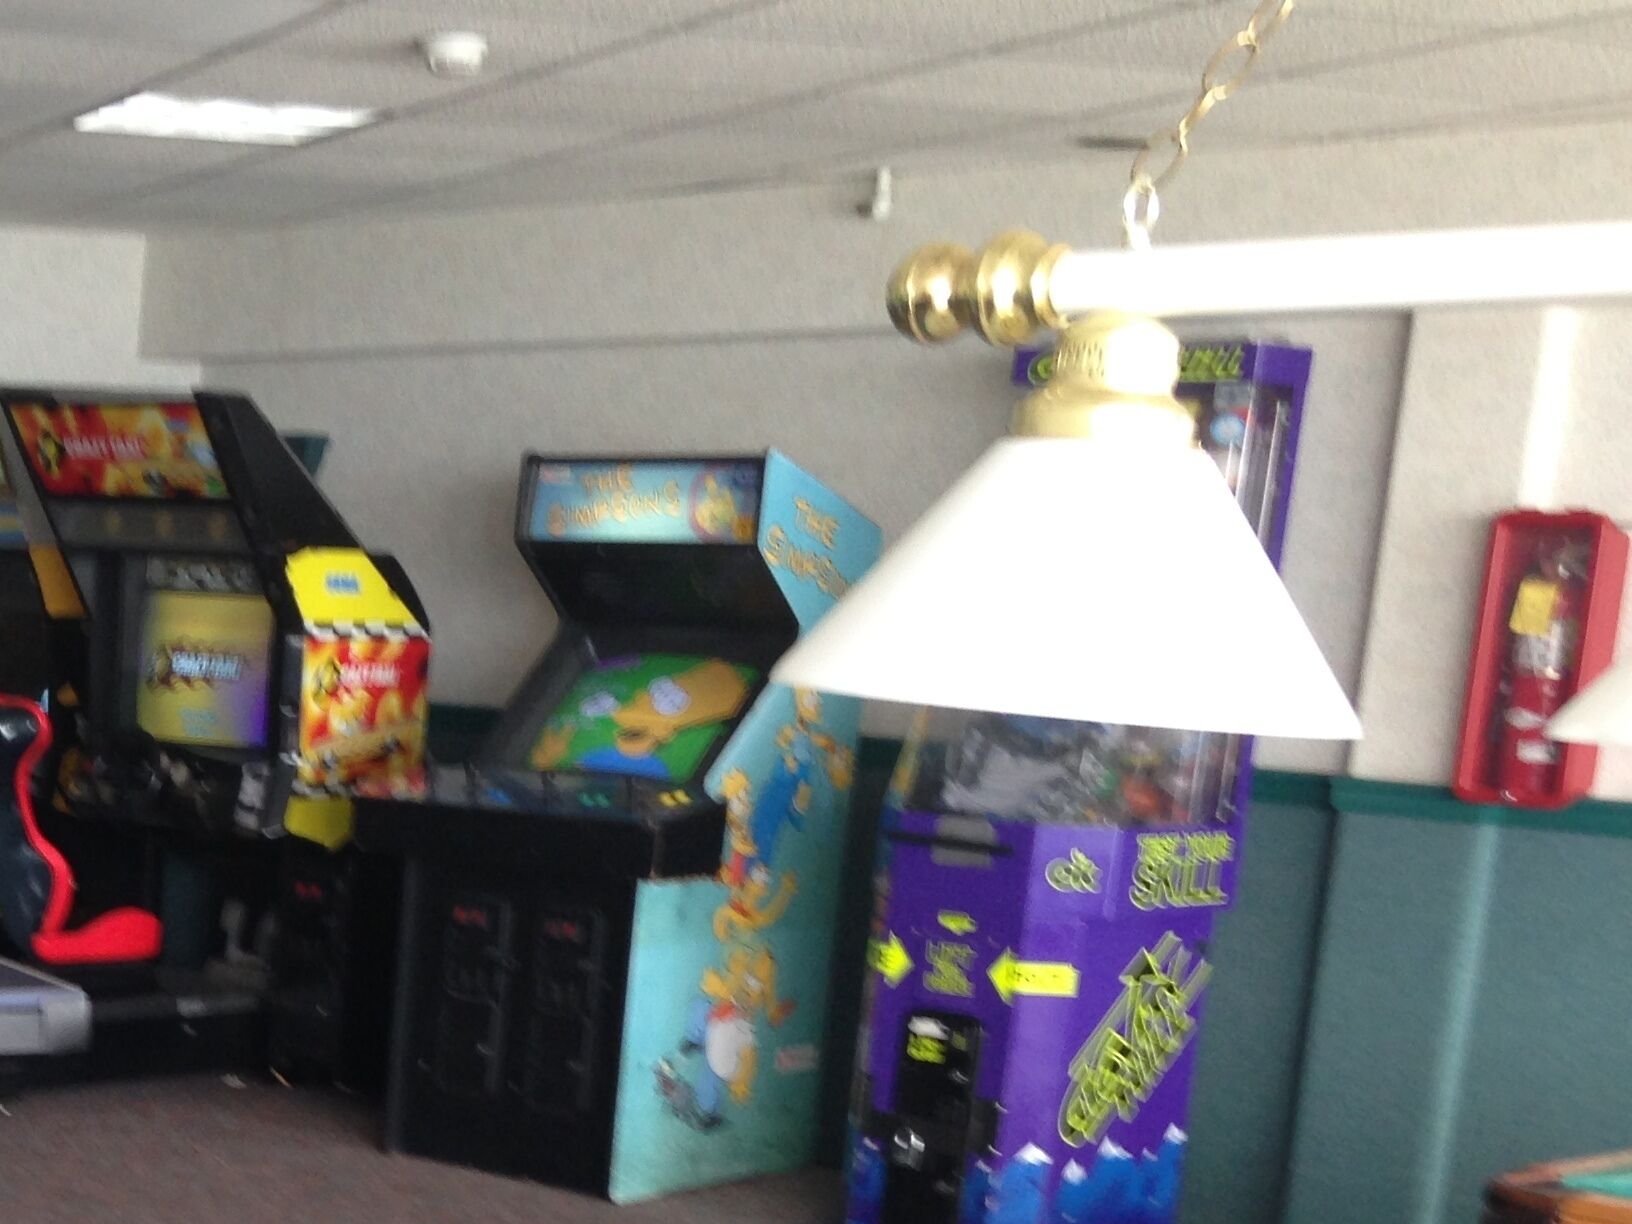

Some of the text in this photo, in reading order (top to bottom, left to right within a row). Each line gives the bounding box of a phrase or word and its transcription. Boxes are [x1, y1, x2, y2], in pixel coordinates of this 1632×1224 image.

[581, 464, 633, 494] THE
[546, 482, 681, 538] SIMPSONS
[793, 497, 838, 550] THE
[1129, 857, 1228, 911] SKILL
